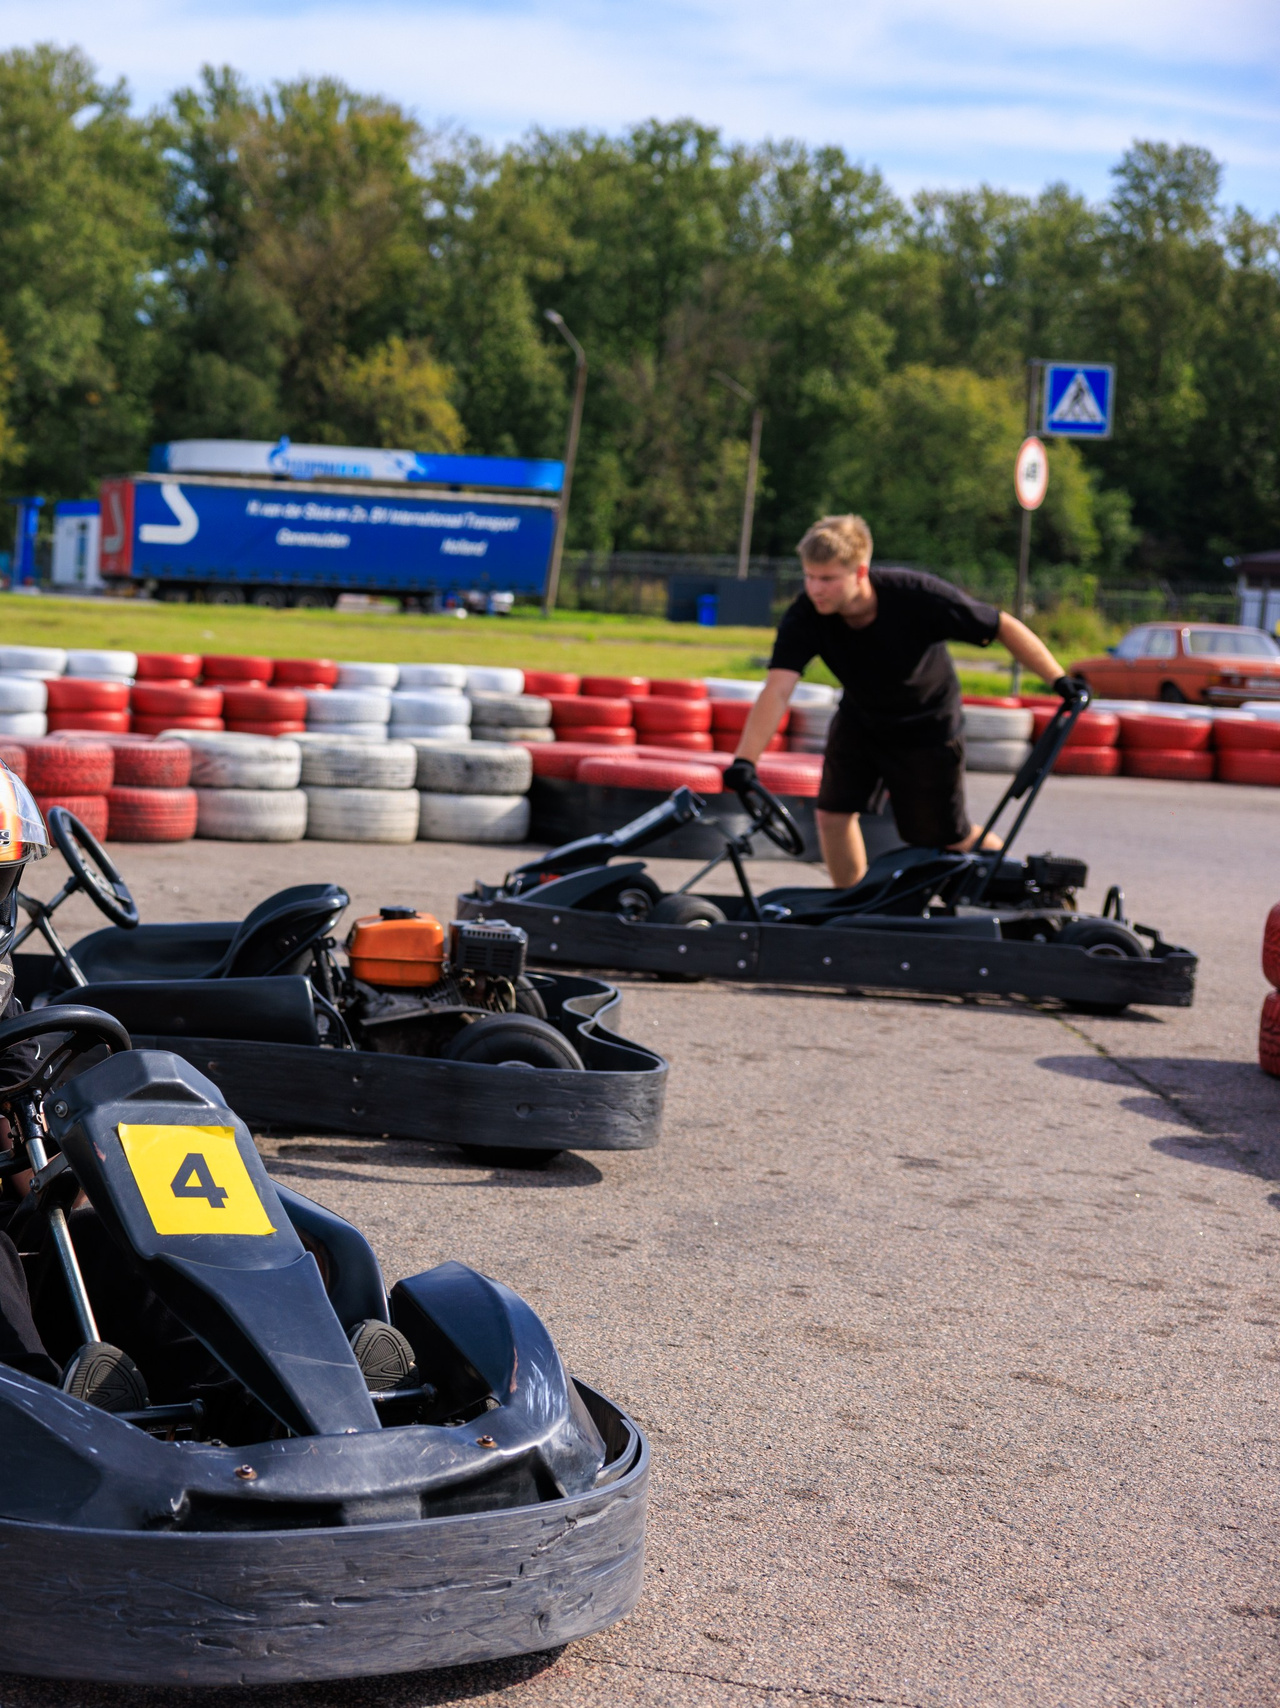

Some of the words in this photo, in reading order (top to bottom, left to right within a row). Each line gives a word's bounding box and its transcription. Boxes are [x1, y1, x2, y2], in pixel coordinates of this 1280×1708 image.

[261, 503, 282, 518] van
[283, 502, 303, 520] der
[304, 503, 333, 522] Sluis
[465, 511, 519, 533] Transport
[441, 537, 488, 556] Holland
[170, 1153, 229, 1208] 4
